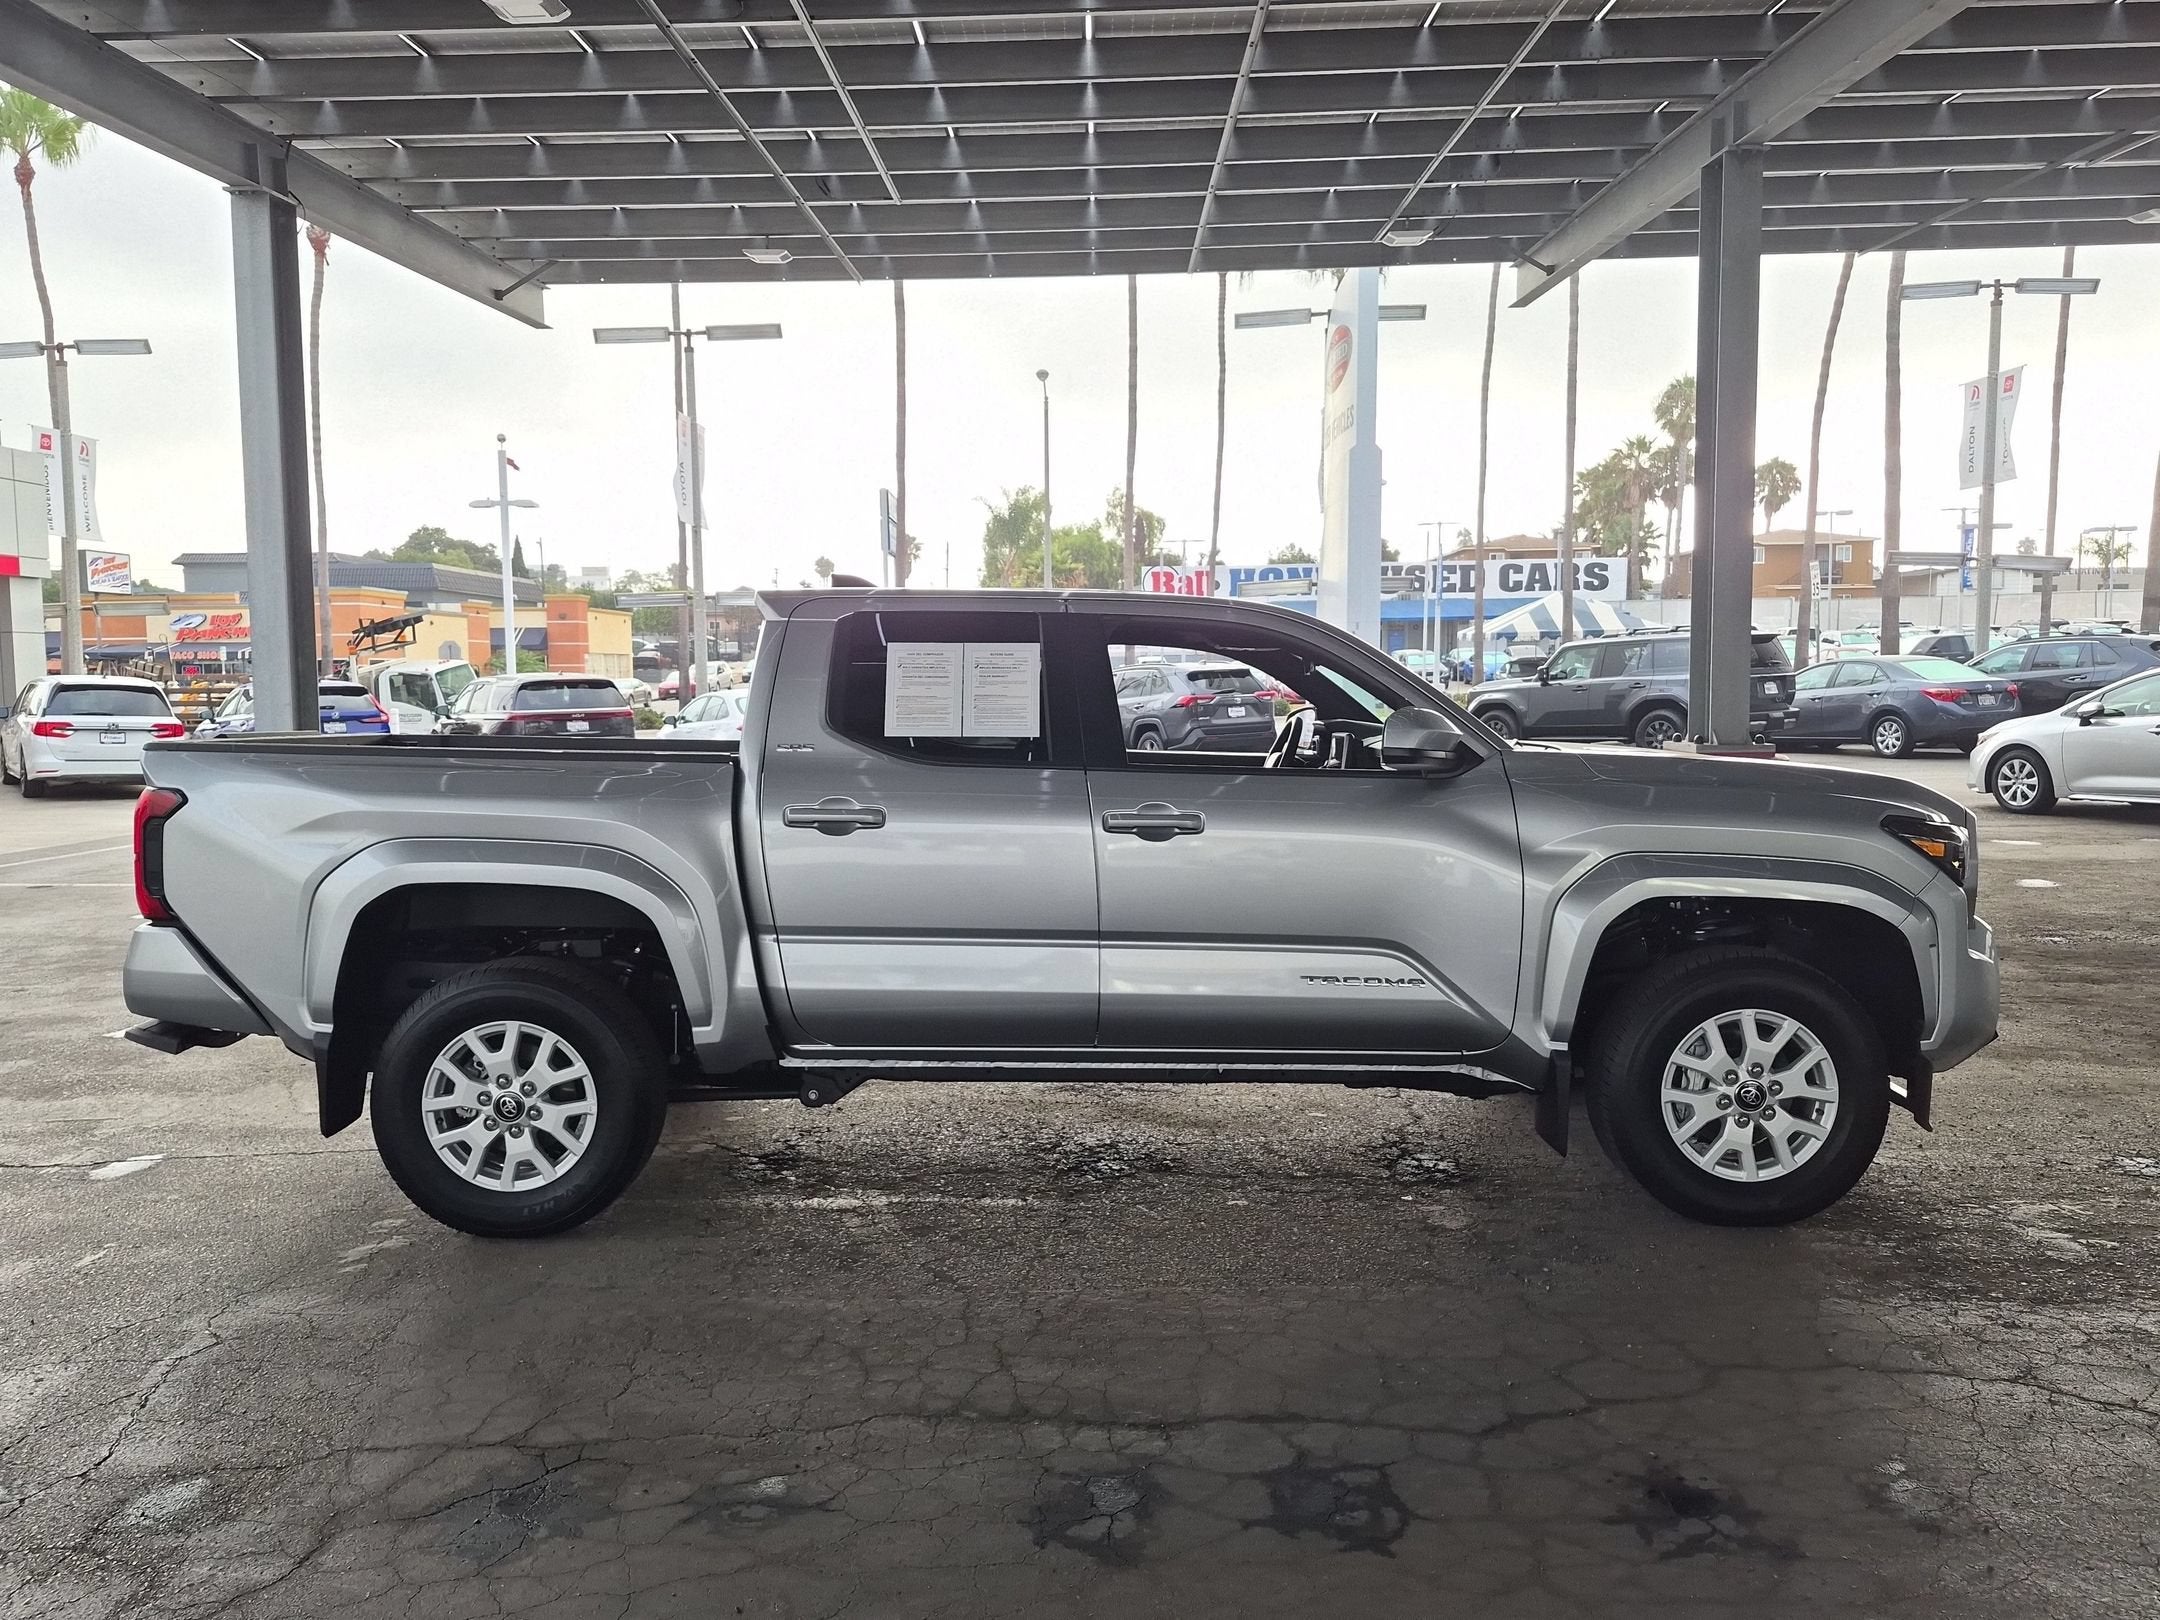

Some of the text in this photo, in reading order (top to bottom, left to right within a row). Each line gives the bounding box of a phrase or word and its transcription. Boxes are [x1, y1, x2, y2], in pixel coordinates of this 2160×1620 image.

[1968, 426, 1976, 473] DALTON
[82, 474, 92, 533] WELCOME
[679, 462, 688, 507] TOYOTA
[1499, 562, 1610, 592] CARS
[1300, 975, 1427, 988] TACOMA
